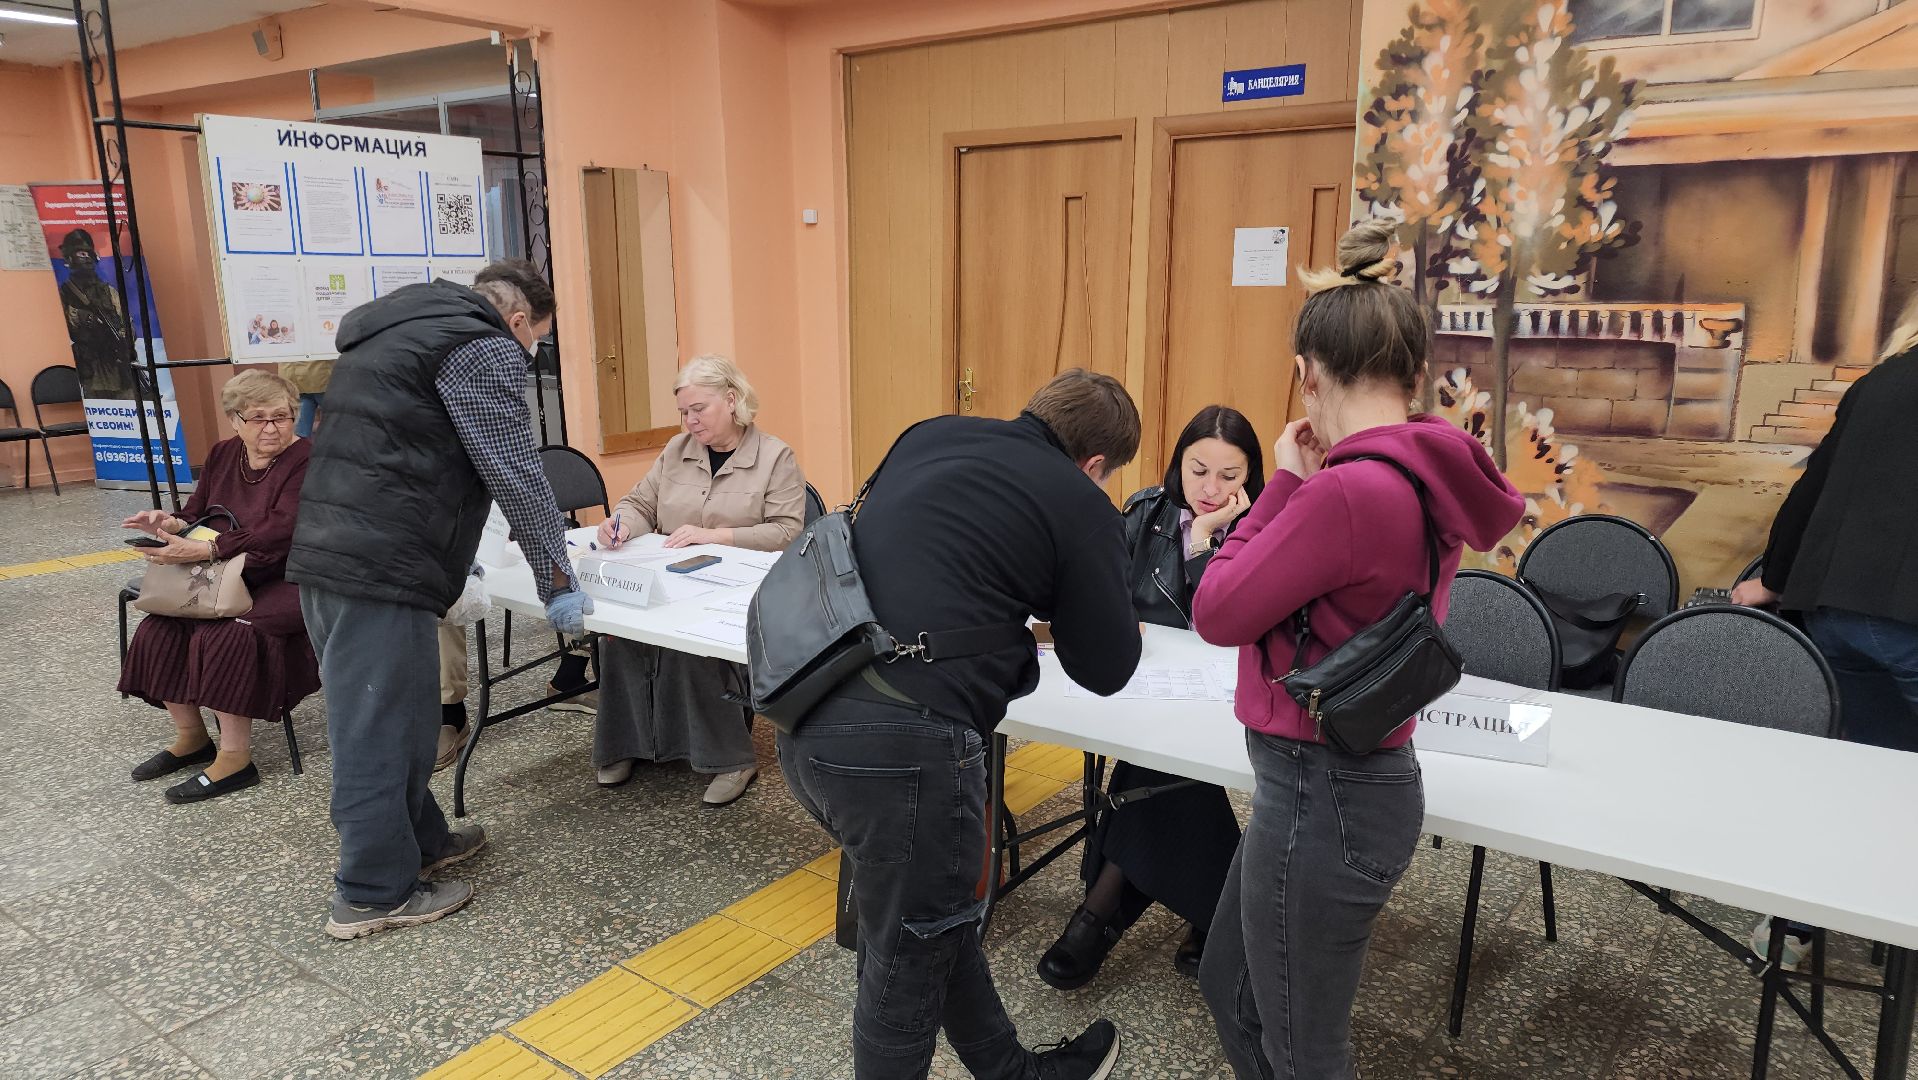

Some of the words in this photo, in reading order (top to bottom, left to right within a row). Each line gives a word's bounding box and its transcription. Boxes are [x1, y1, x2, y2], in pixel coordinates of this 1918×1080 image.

[1247, 75, 1299, 90] КАНЦЕЛЯРИЯ
[277, 128, 427, 160] ИНФОРМАЦИЯ
[89, 421, 95, 430] К
[96, 421, 135, 431] СВОИМ!
